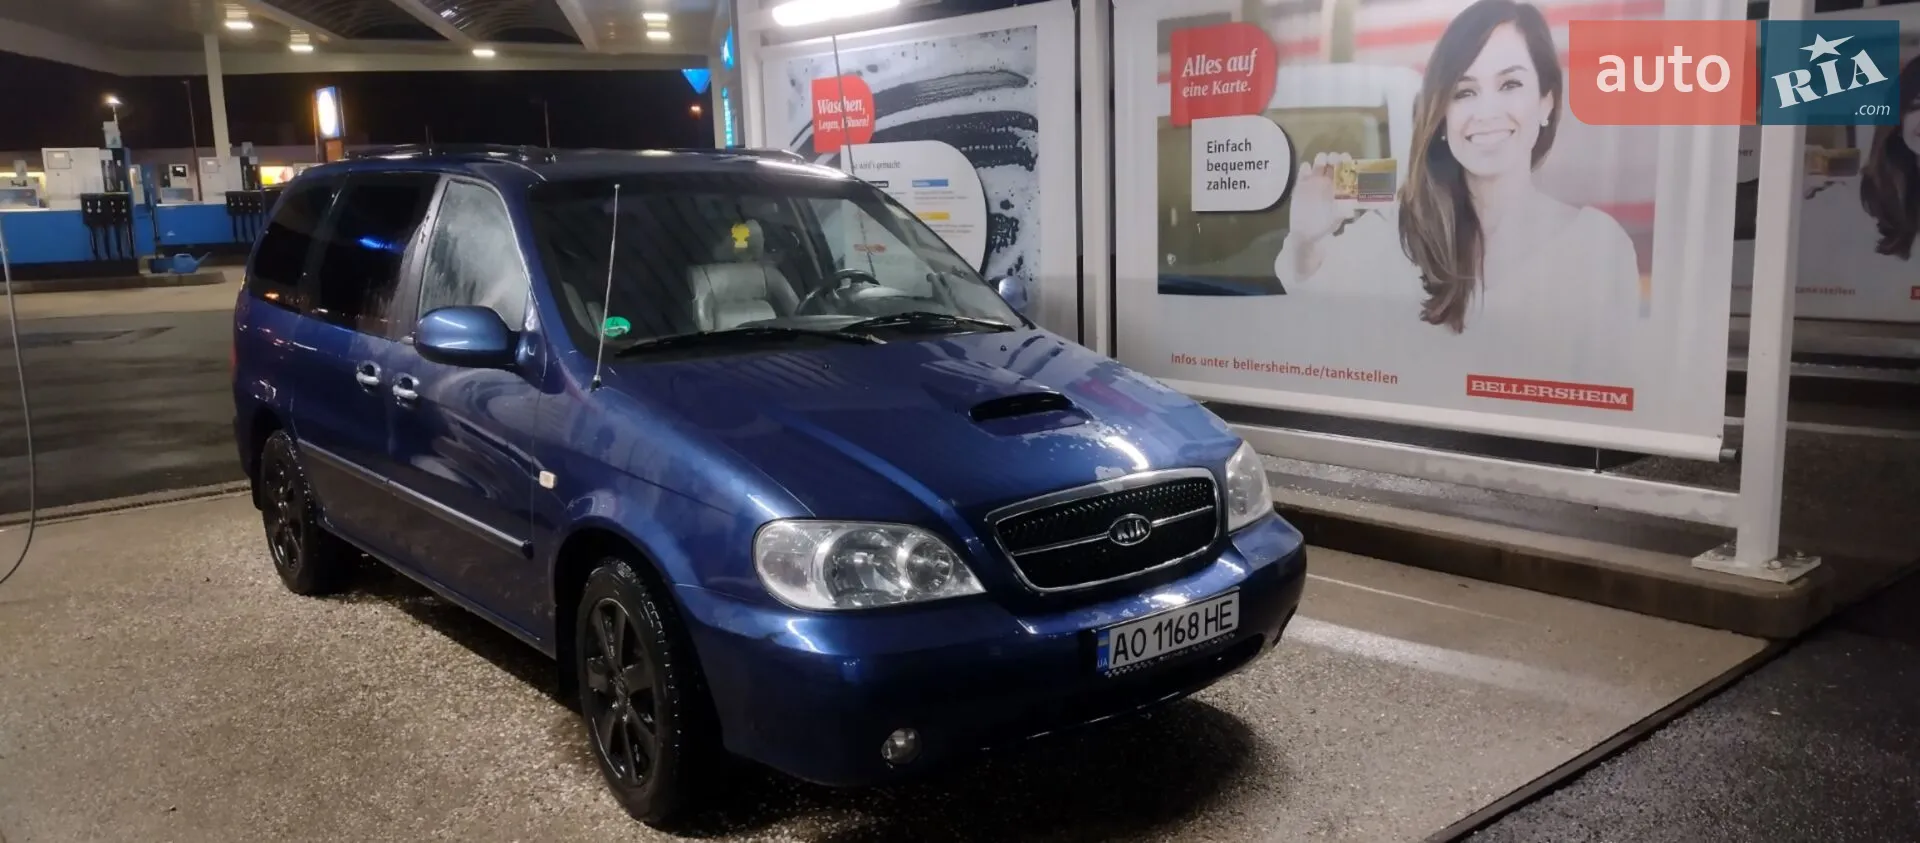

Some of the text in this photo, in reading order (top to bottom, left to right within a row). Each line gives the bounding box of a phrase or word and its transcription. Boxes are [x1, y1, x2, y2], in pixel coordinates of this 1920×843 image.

[1181, 48, 1258, 78] Alles auf
[1182, 80, 1252, 98] eine Karte.
[1206, 138, 1252, 154] Einfach
[1206, 159, 1270, 174] bequemer
[1206, 177, 1251, 191] zahlen.
[1171, 352, 1399, 385] Infos unter bellersheim.de/tankstellen
[1471, 380, 1629, 405] BELLERSHEIM
[1112, 628, 1147, 665] AO
[1153, 611, 1200, 650] 1168
[1204, 600, 1233, 637] HE
